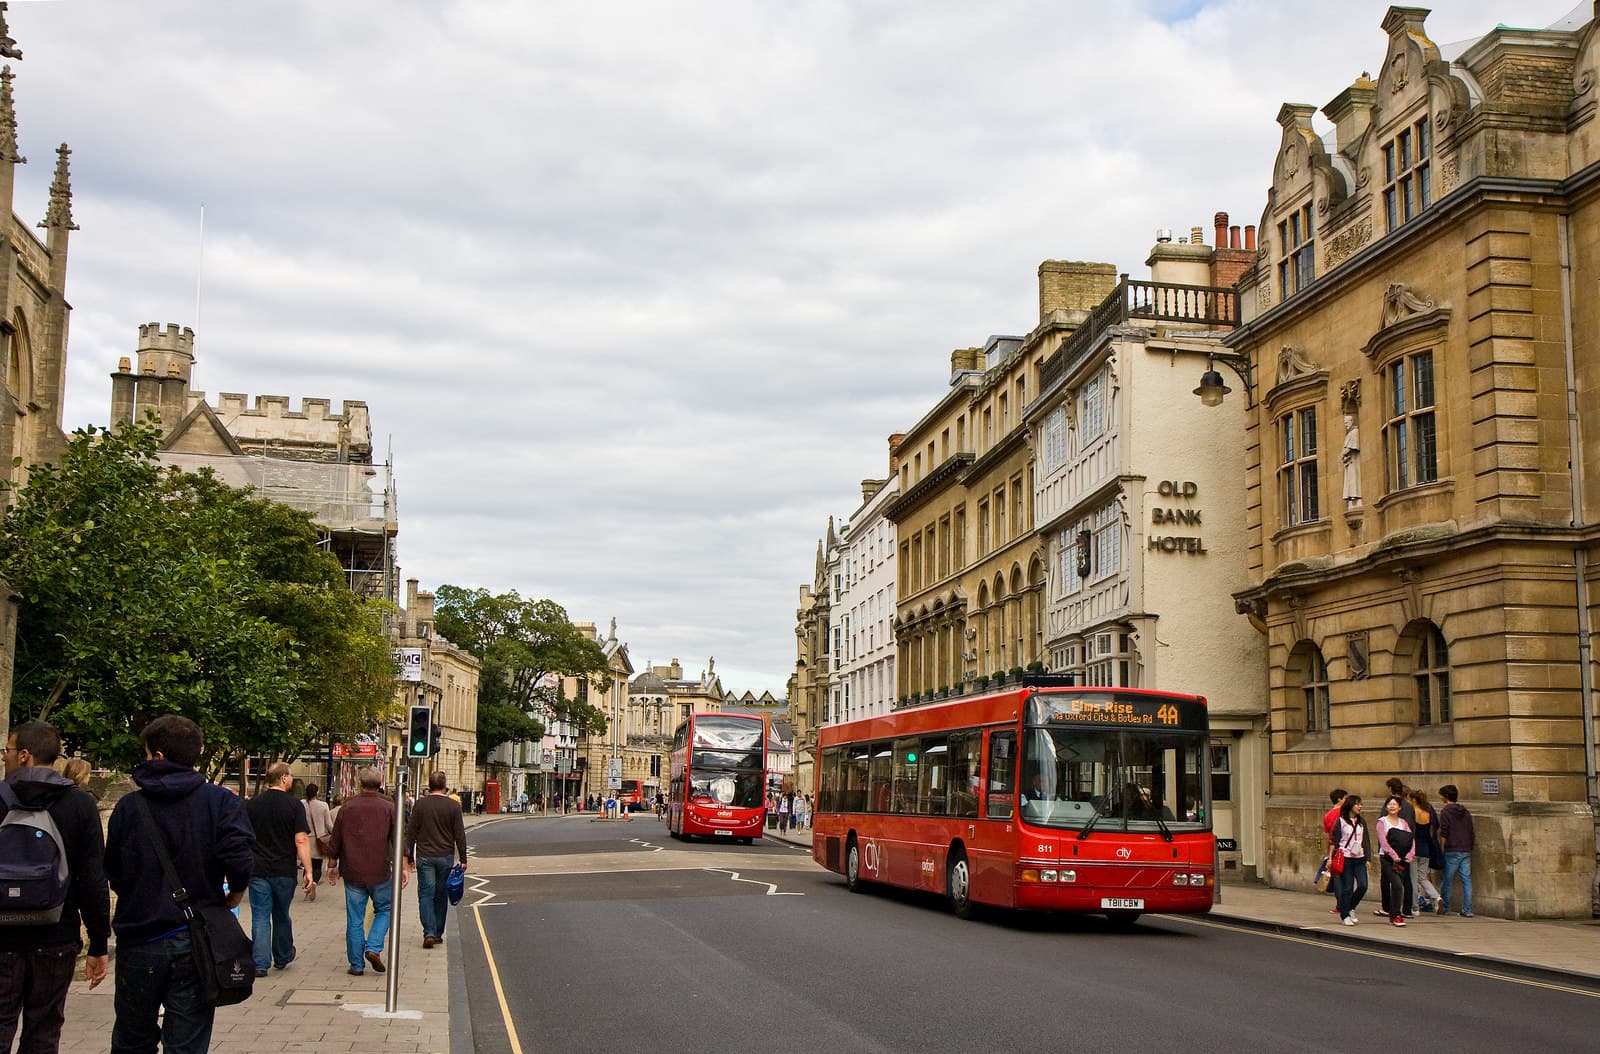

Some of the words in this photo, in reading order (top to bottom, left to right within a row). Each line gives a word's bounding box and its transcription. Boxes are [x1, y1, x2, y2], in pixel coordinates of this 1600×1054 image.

[1158, 480, 1198, 497] OLD
[1152, 508, 1202, 526] BANK
[1148, 536, 1208, 554] HOTEL
[1071, 700, 1101, 712] Elms
[1104, 701, 1134, 713] Rise
[1065, 711, 1092, 721] Oxford
[1093, 712, 1109, 722] City
[1111, 713, 1116, 722] &
[1118, 713, 1141, 724] Botley
[1142, 714, 1153, 724] Rd
[1157, 703, 1179, 725] 4A
[1038, 844, 1052, 852] 811
[1217, 841, 1233, 849] ANE
[864, 840, 881, 878] city
[1116, 847, 1132, 858] city
[921, 859, 935, 872] oxford
[1108, 898, 1122, 907] T811
[1123, 899, 1139, 908] CBW
